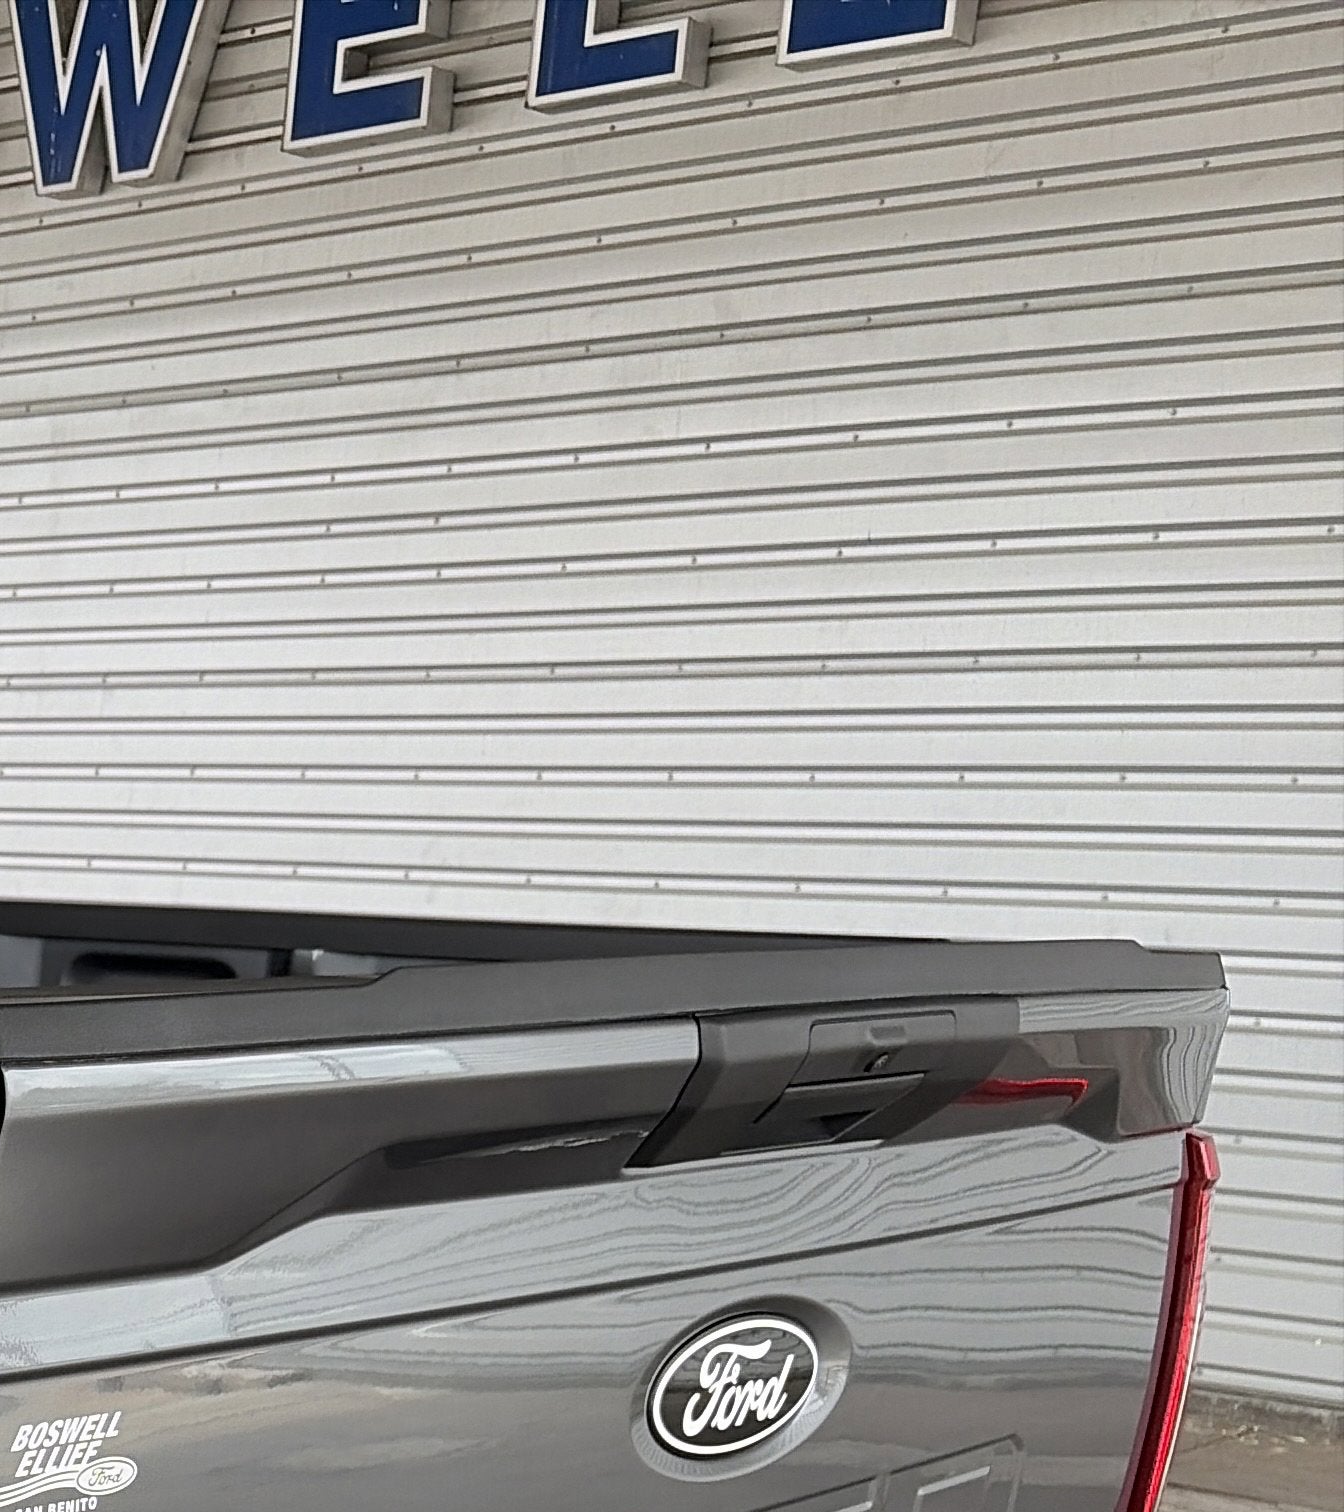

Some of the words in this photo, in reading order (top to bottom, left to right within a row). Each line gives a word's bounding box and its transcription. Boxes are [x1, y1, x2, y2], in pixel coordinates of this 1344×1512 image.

[682, 1338, 795, 1437] Ford
[10, 1411, 122, 1452] BOSWELL
[14, 1440, 103, 1478] ELLIFF
[88, 1466, 124, 1487] Ford
